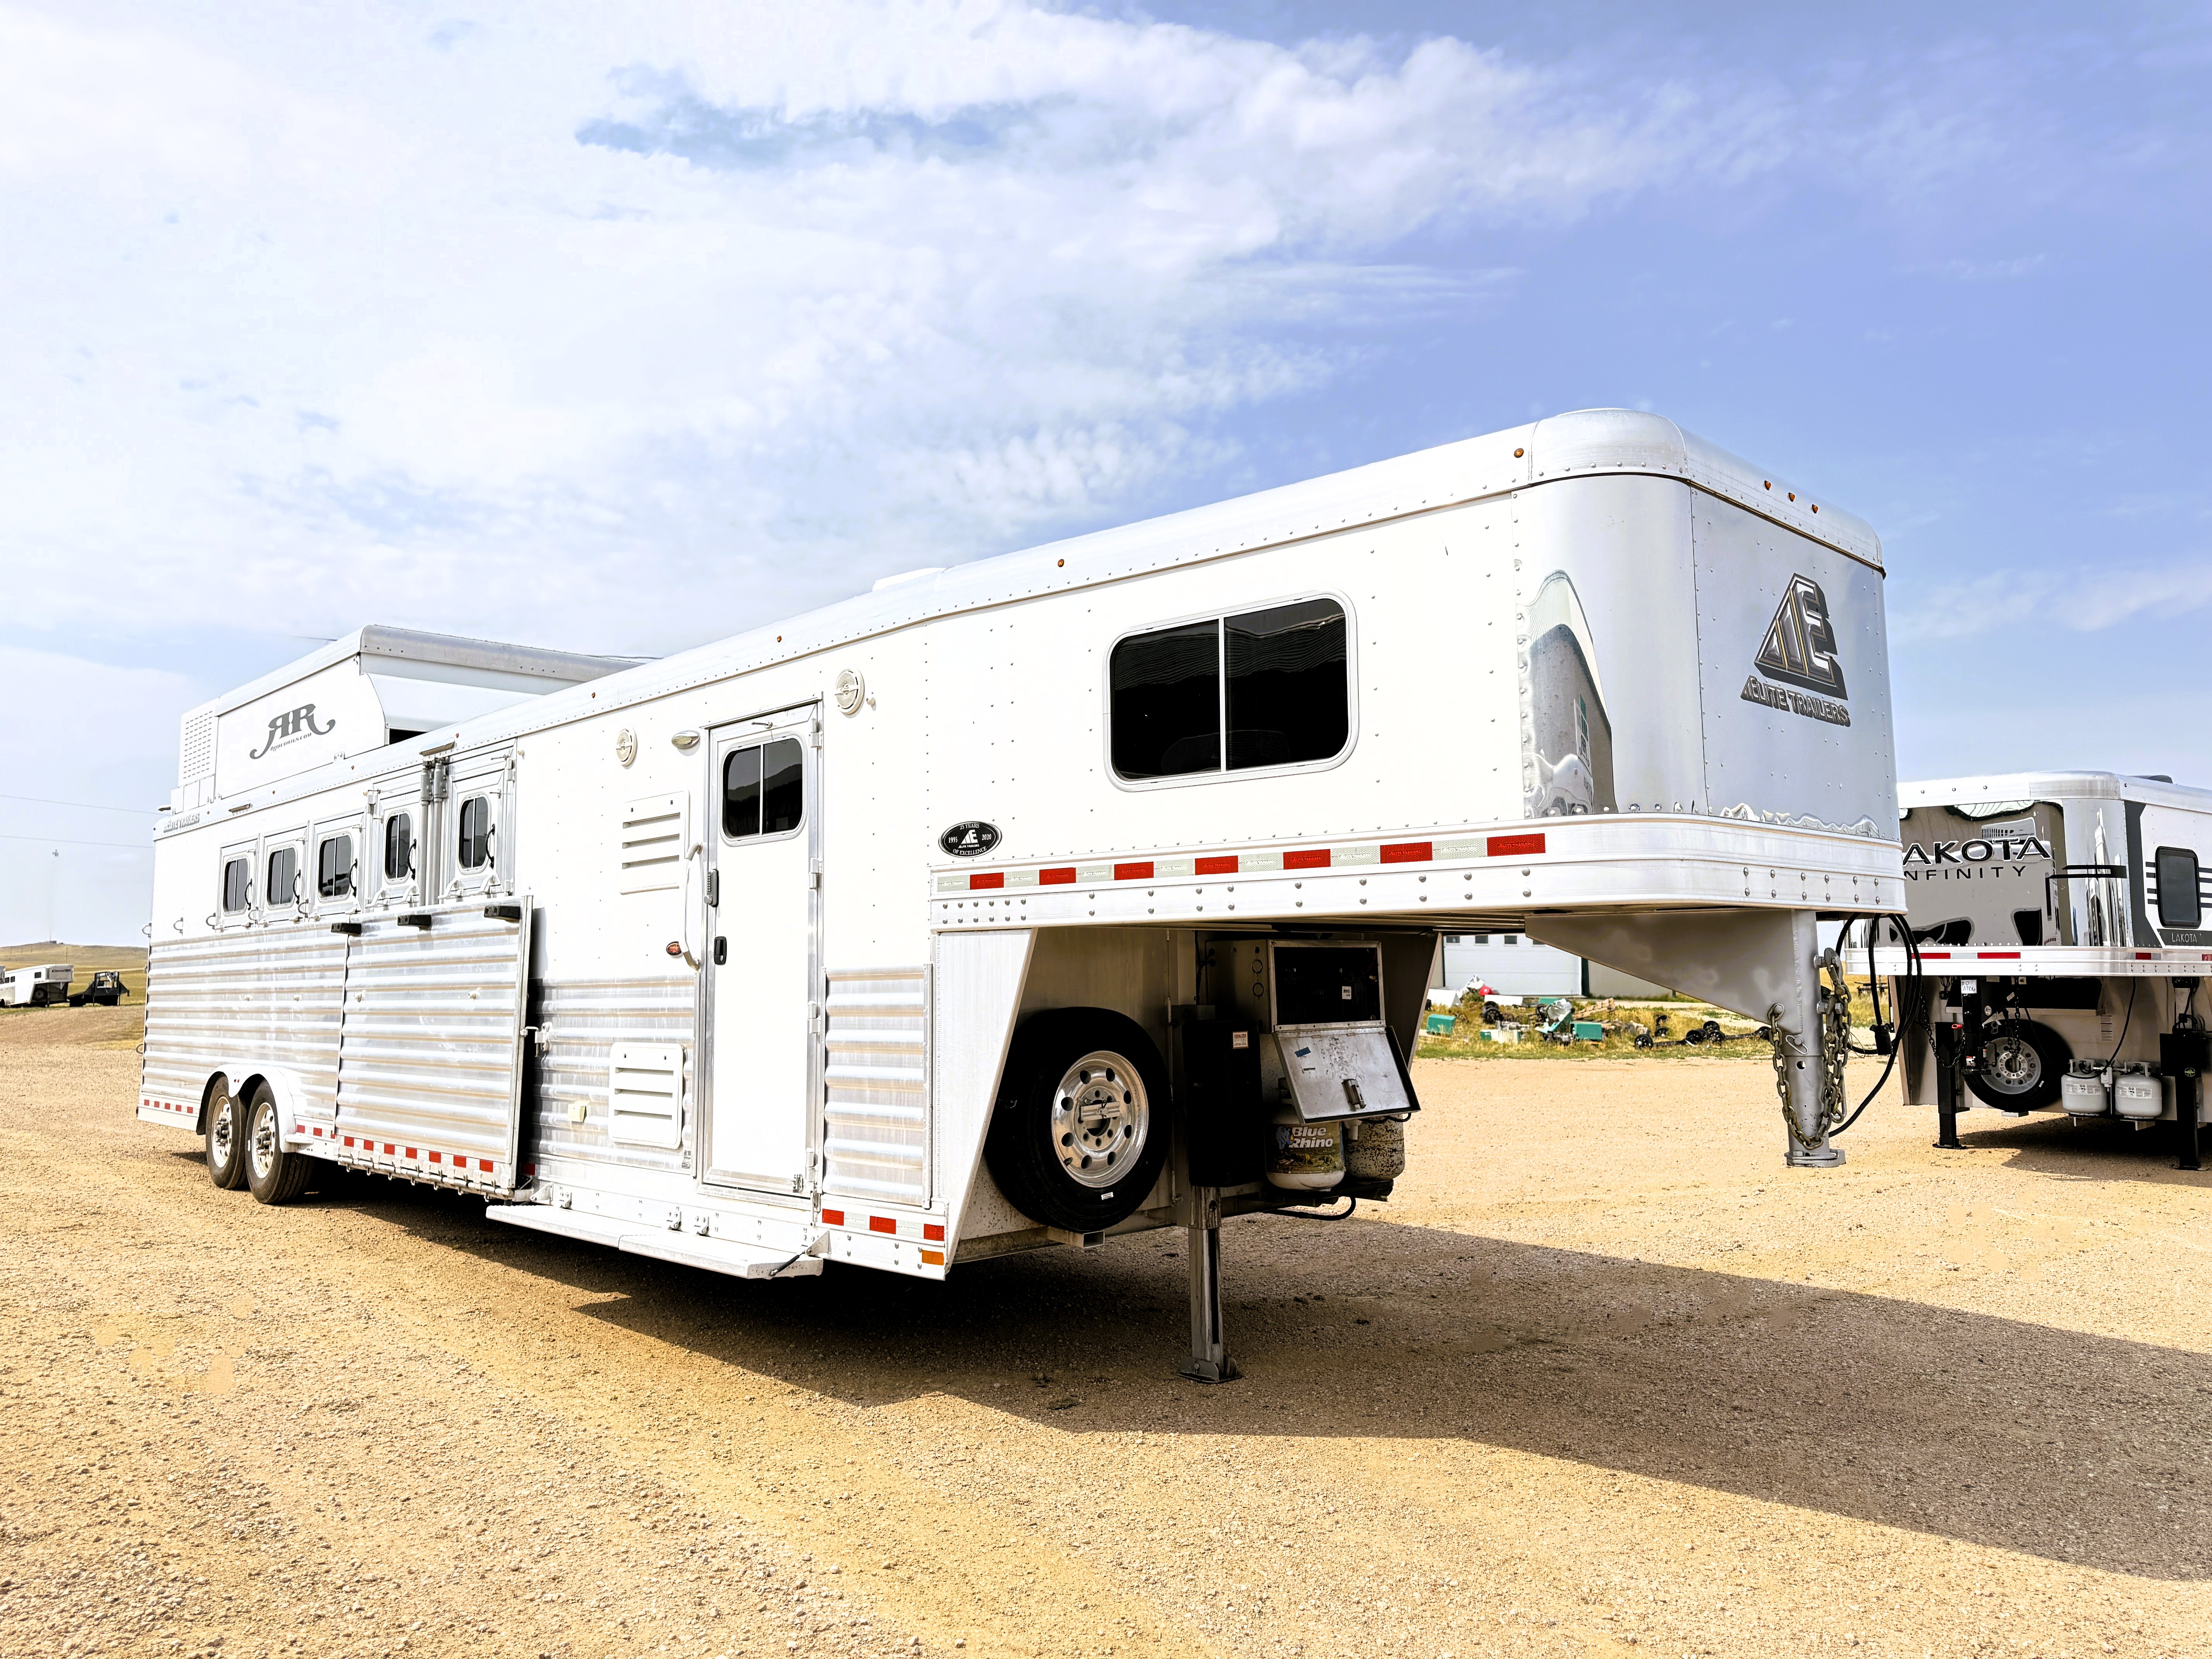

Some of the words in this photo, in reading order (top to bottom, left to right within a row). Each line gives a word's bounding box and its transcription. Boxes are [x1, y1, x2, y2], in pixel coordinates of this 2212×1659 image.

[1786, 690, 1851, 727] TRAILERS
[960, 846, 987, 855] EXCELLENCE
[1903, 836, 2052, 867] AKOTA
[1904, 865, 2026, 881] NFINITY
[2172, 933, 2197, 943] LAKOTA
[1292, 1127, 1326, 1137] Blue
[1289, 1137, 1333, 1148] Rhino
